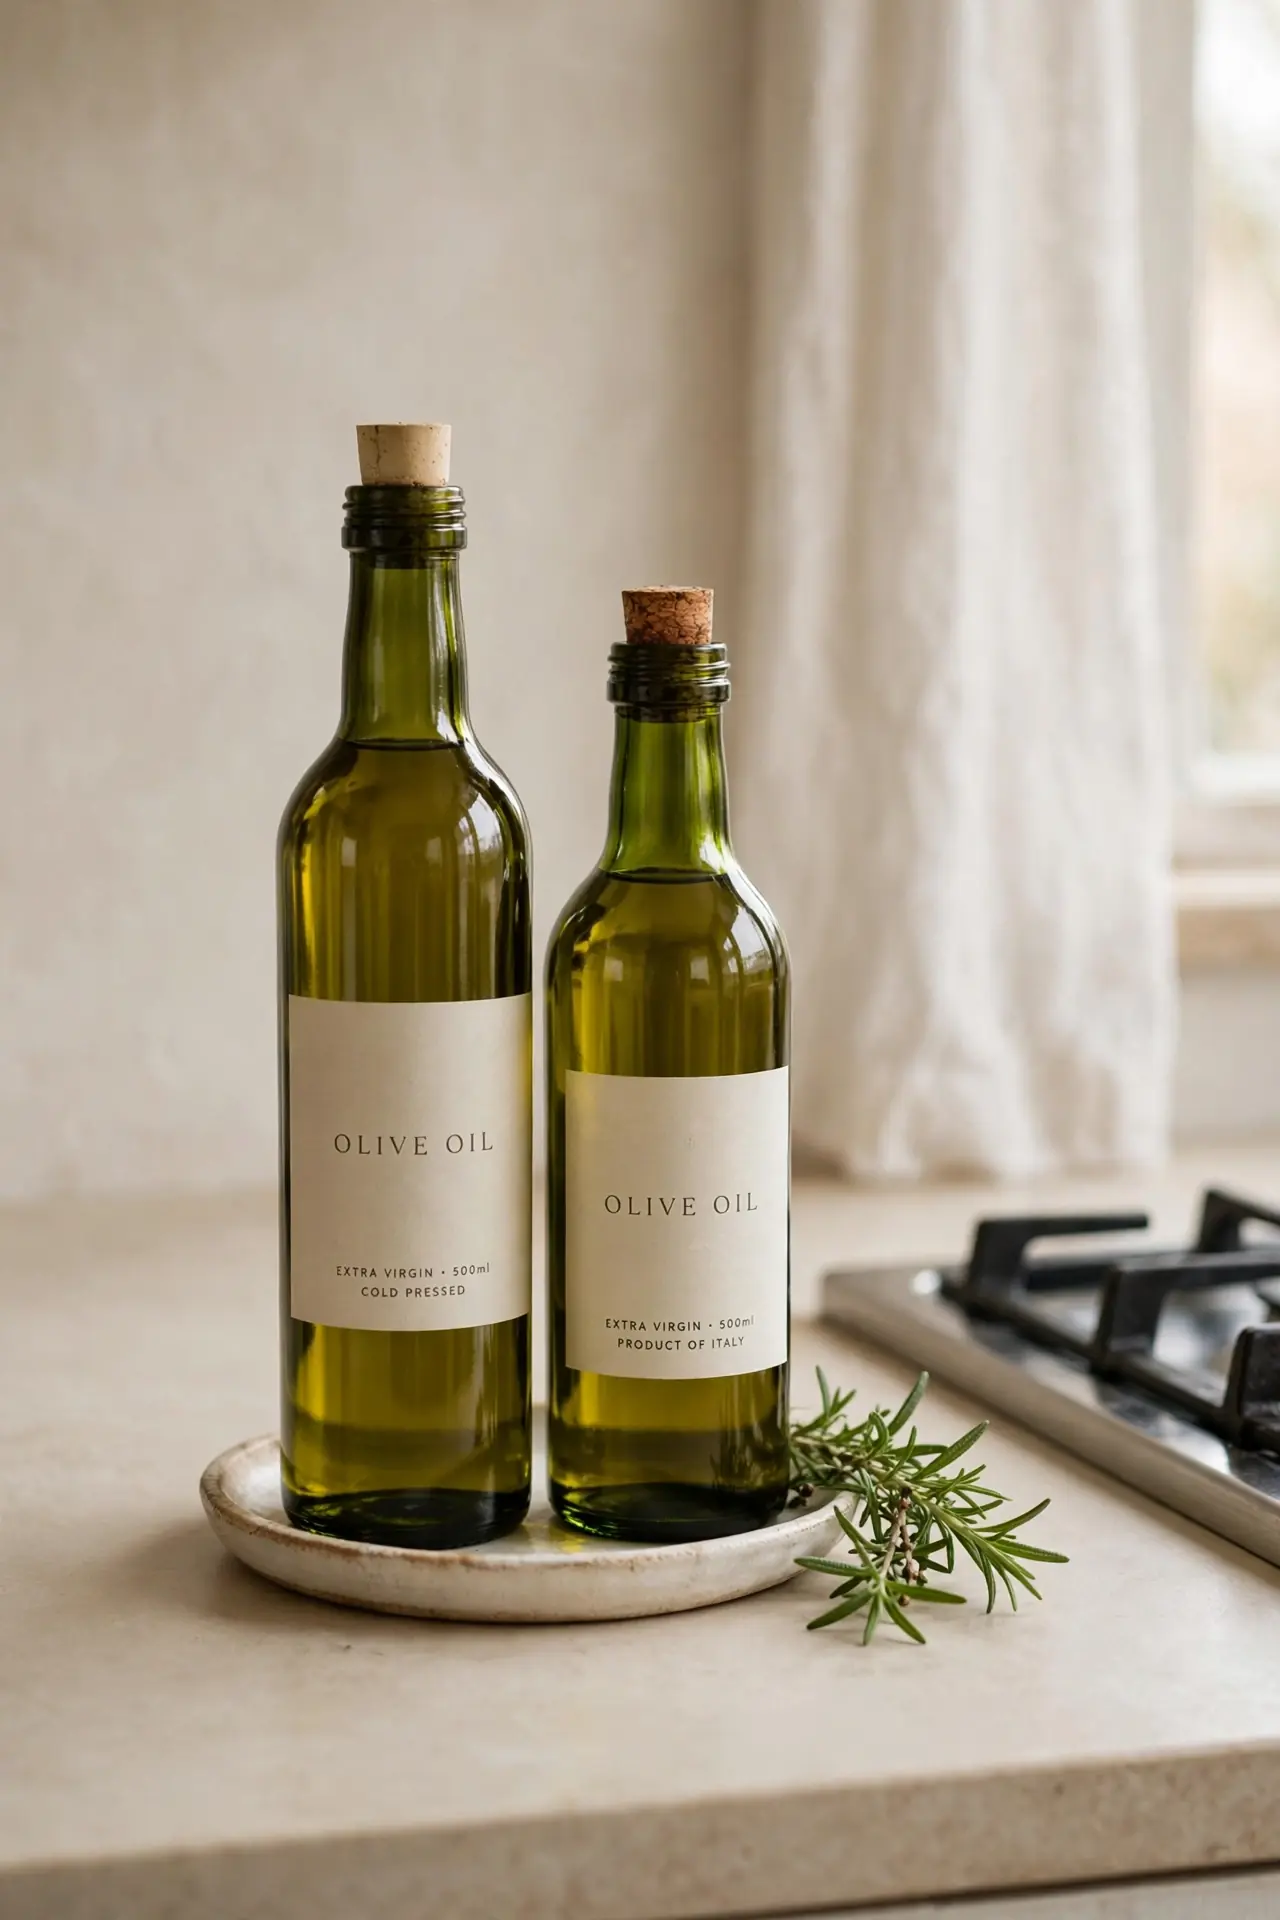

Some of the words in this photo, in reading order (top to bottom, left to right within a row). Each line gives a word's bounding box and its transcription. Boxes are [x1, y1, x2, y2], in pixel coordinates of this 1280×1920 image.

[334, 1133, 428, 1156] OLIVE
[446, 1131, 494, 1153] OIL
[604, 1194, 697, 1216] OLIVE
[713, 1192, 758, 1214] OIL
[336, 1265, 377, 1278] EXTRA
[384, 1267, 433, 1279] VIRGIN
[453, 1262, 490, 1276] 500ml
[361, 1286, 398, 1298] COLD
[405, 1285, 465, 1298] PRESSED
[605, 1318, 647, 1332] EXTRA
[653, 1320, 701, 1332] VIRGIN
[719, 1315, 754, 1330] 500ml
[617, 1338, 681, 1351] PRODUCT
[687, 1339, 705, 1350] OF
[711, 1336, 745, 1349] ITALY
